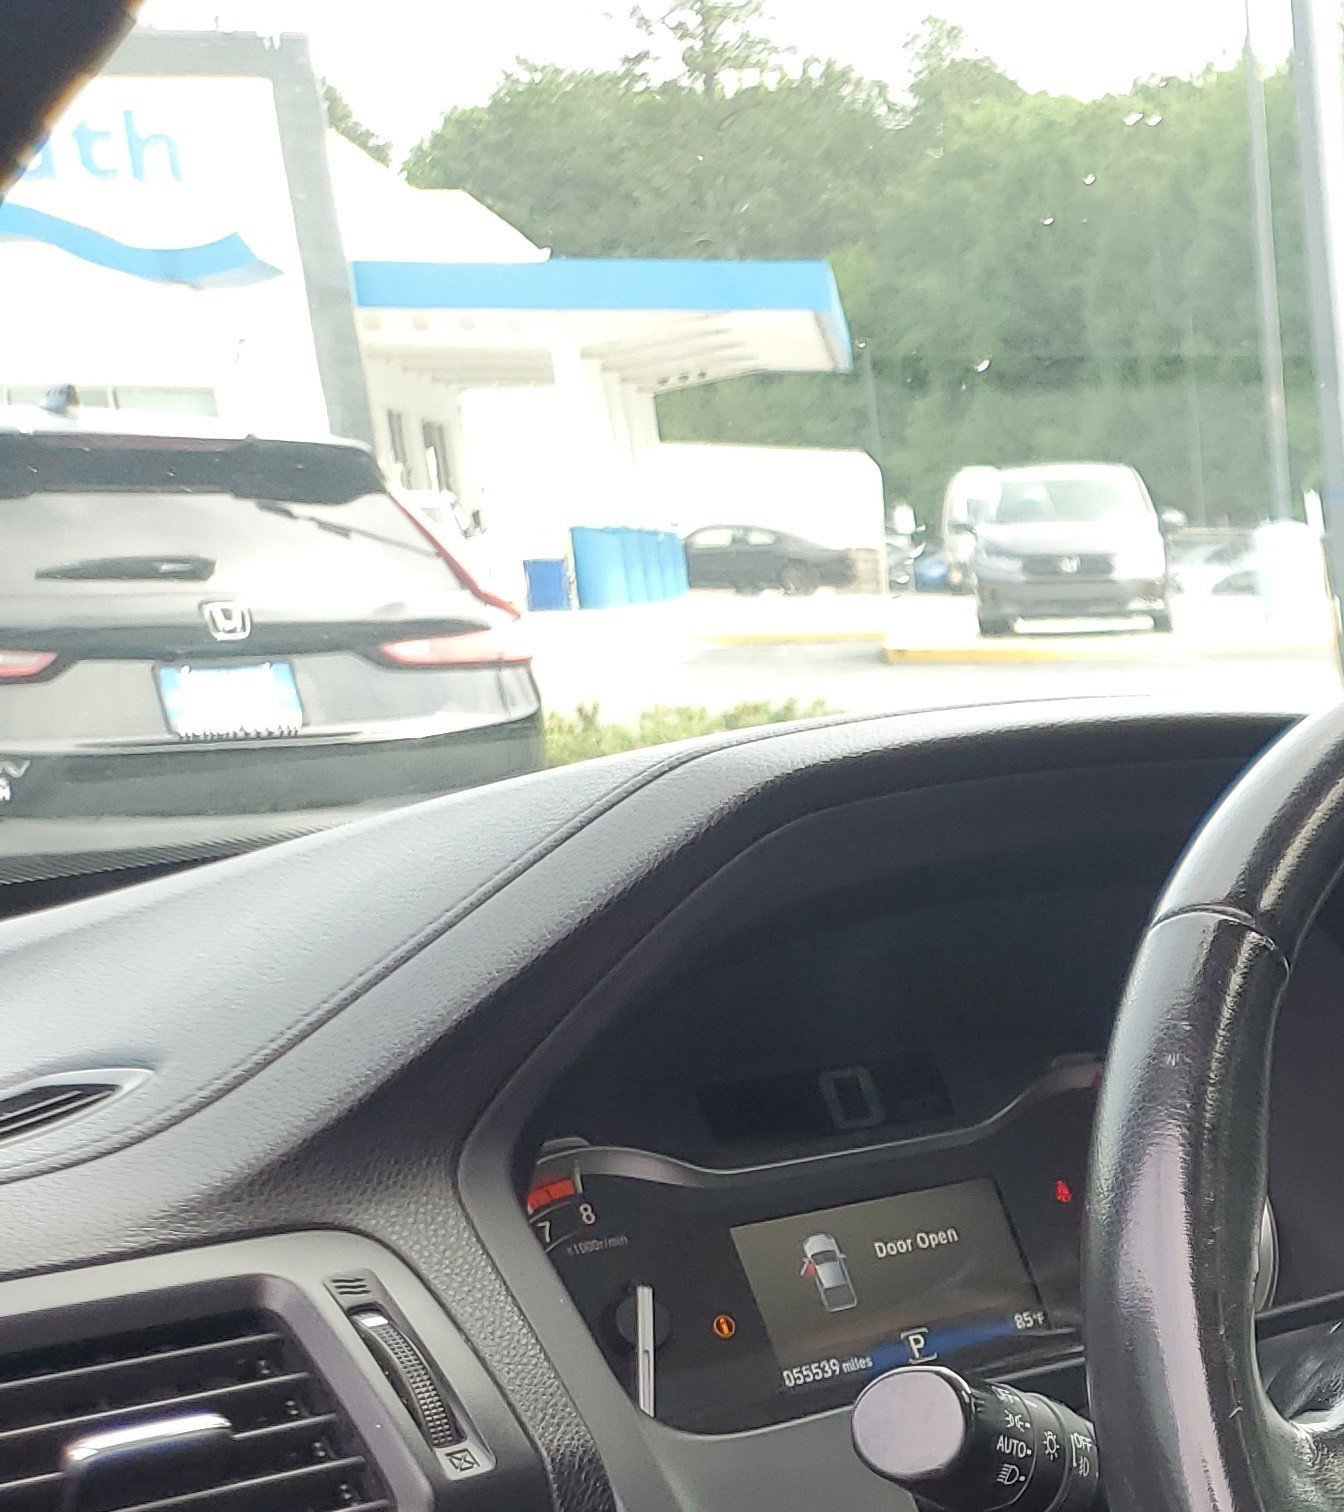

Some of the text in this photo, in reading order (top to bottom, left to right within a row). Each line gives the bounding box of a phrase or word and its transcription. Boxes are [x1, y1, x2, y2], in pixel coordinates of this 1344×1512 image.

[579, 1203, 596, 1225] 8
[536, 1221, 550, 1243] 7
[873, 1227, 959, 1258] Door Open
[908, 1333, 927, 1358] P
[782, 1355, 873, 1388] 055539 miles
[996, 1434, 1027, 1459] AUTO
[1074, 1432, 1093, 1452] OFF
